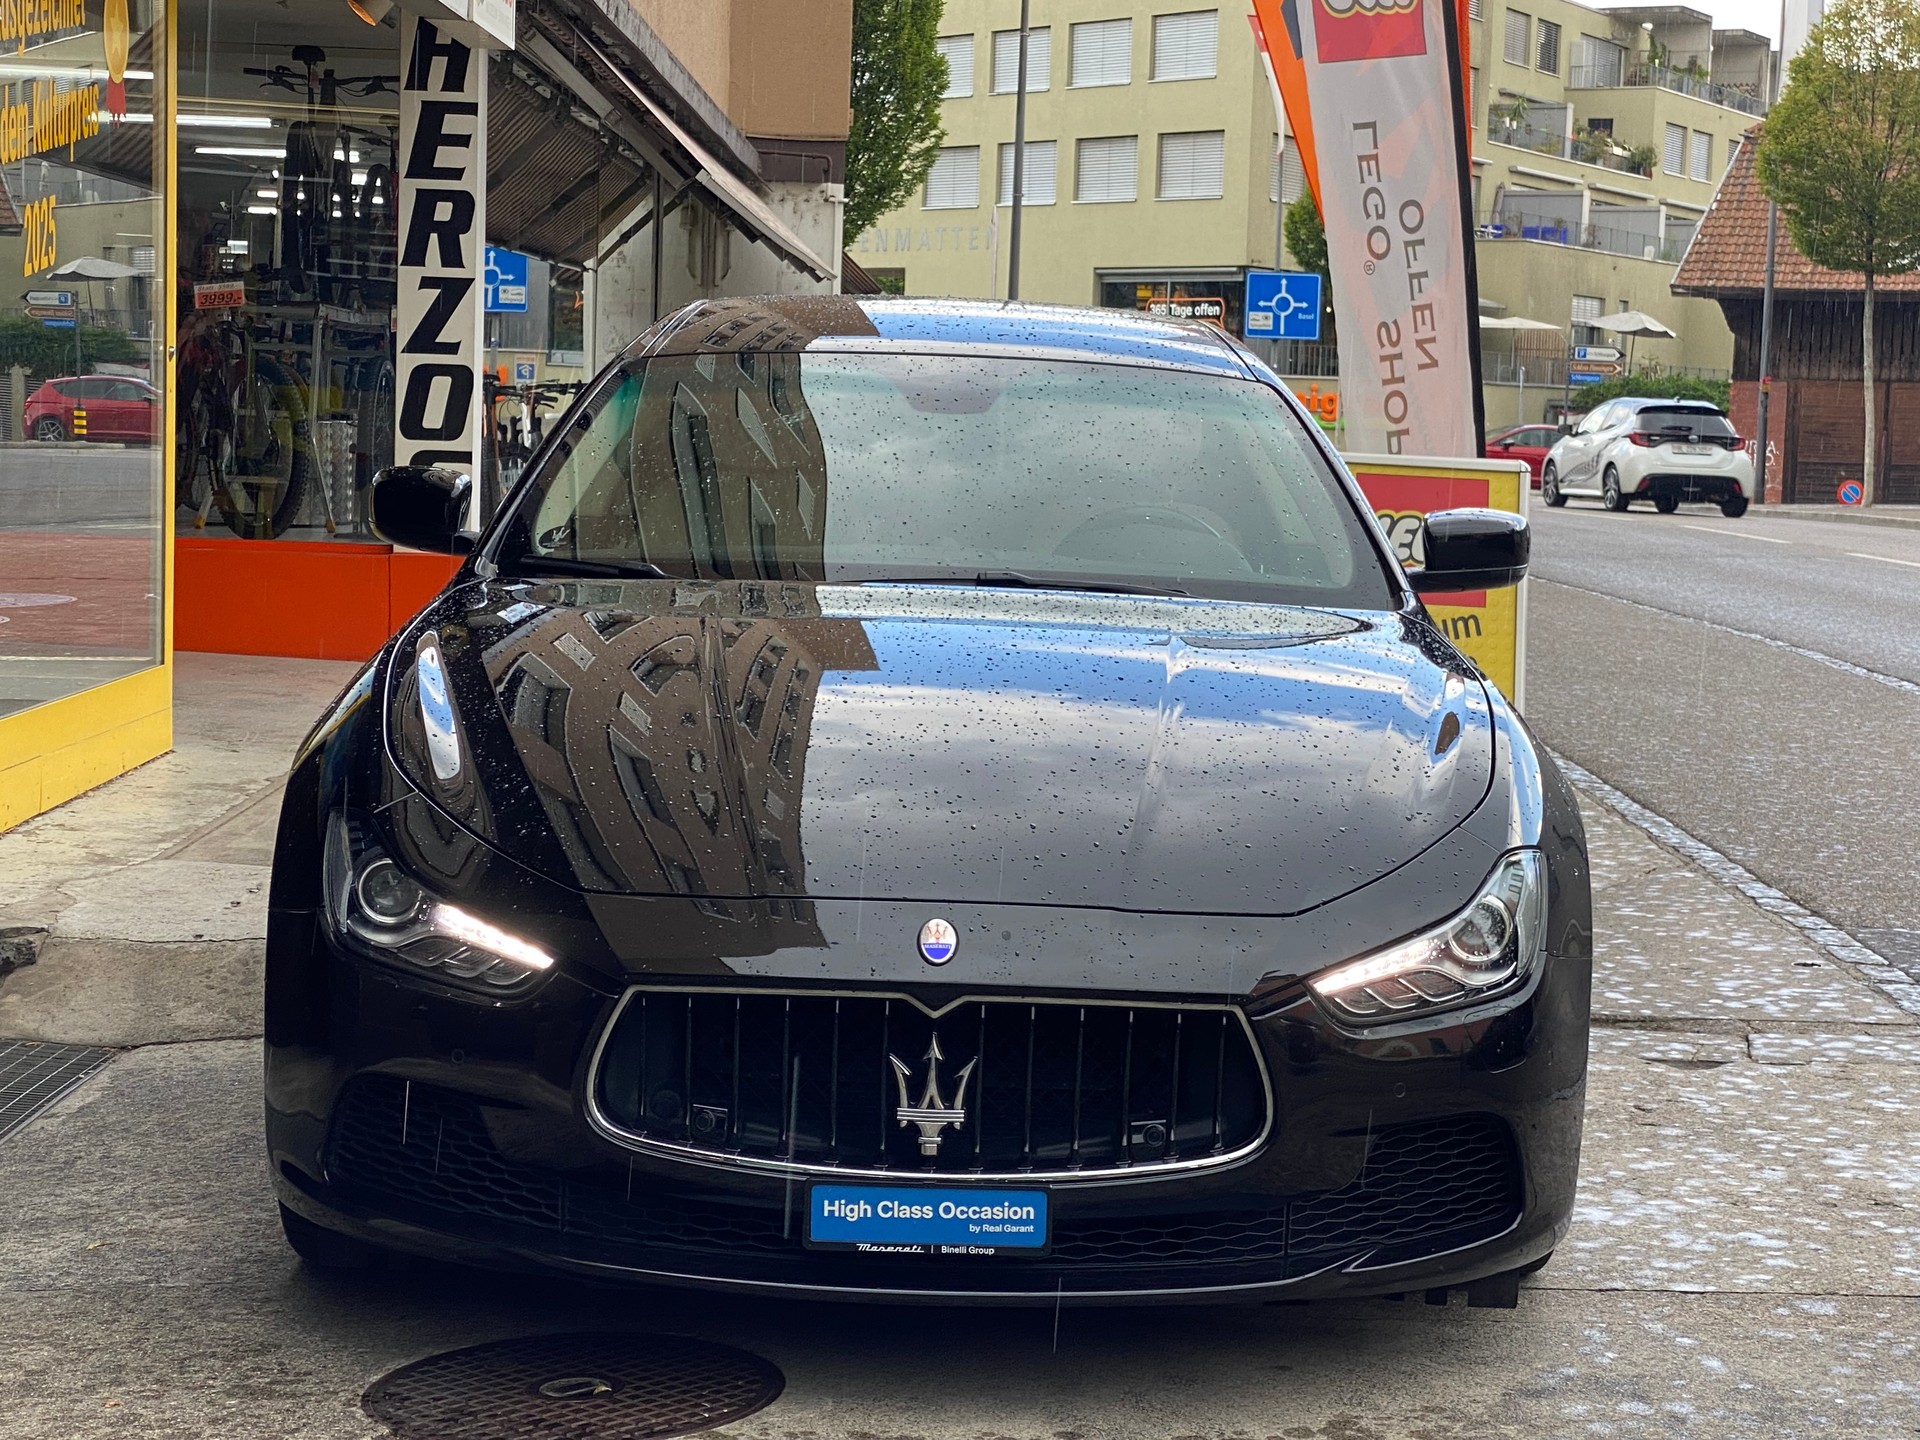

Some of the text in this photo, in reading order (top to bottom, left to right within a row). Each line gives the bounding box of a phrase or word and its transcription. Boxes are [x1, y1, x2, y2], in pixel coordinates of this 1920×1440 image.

[0, 75, 99, 164] dem Kulturpreis
[23, 194, 56, 278] 2025
[399, 16, 478, 467] HERZO
[200, 292, 242, 305] 3999.-
[1149, 303, 1220, 318] 365 Tage offen
[823, 1200, 1035, 1222] High Class Occasion
[969, 1224, 1034, 1233] by Real Garant
[856, 1243, 995, 1256] Maserati Binelli Group
